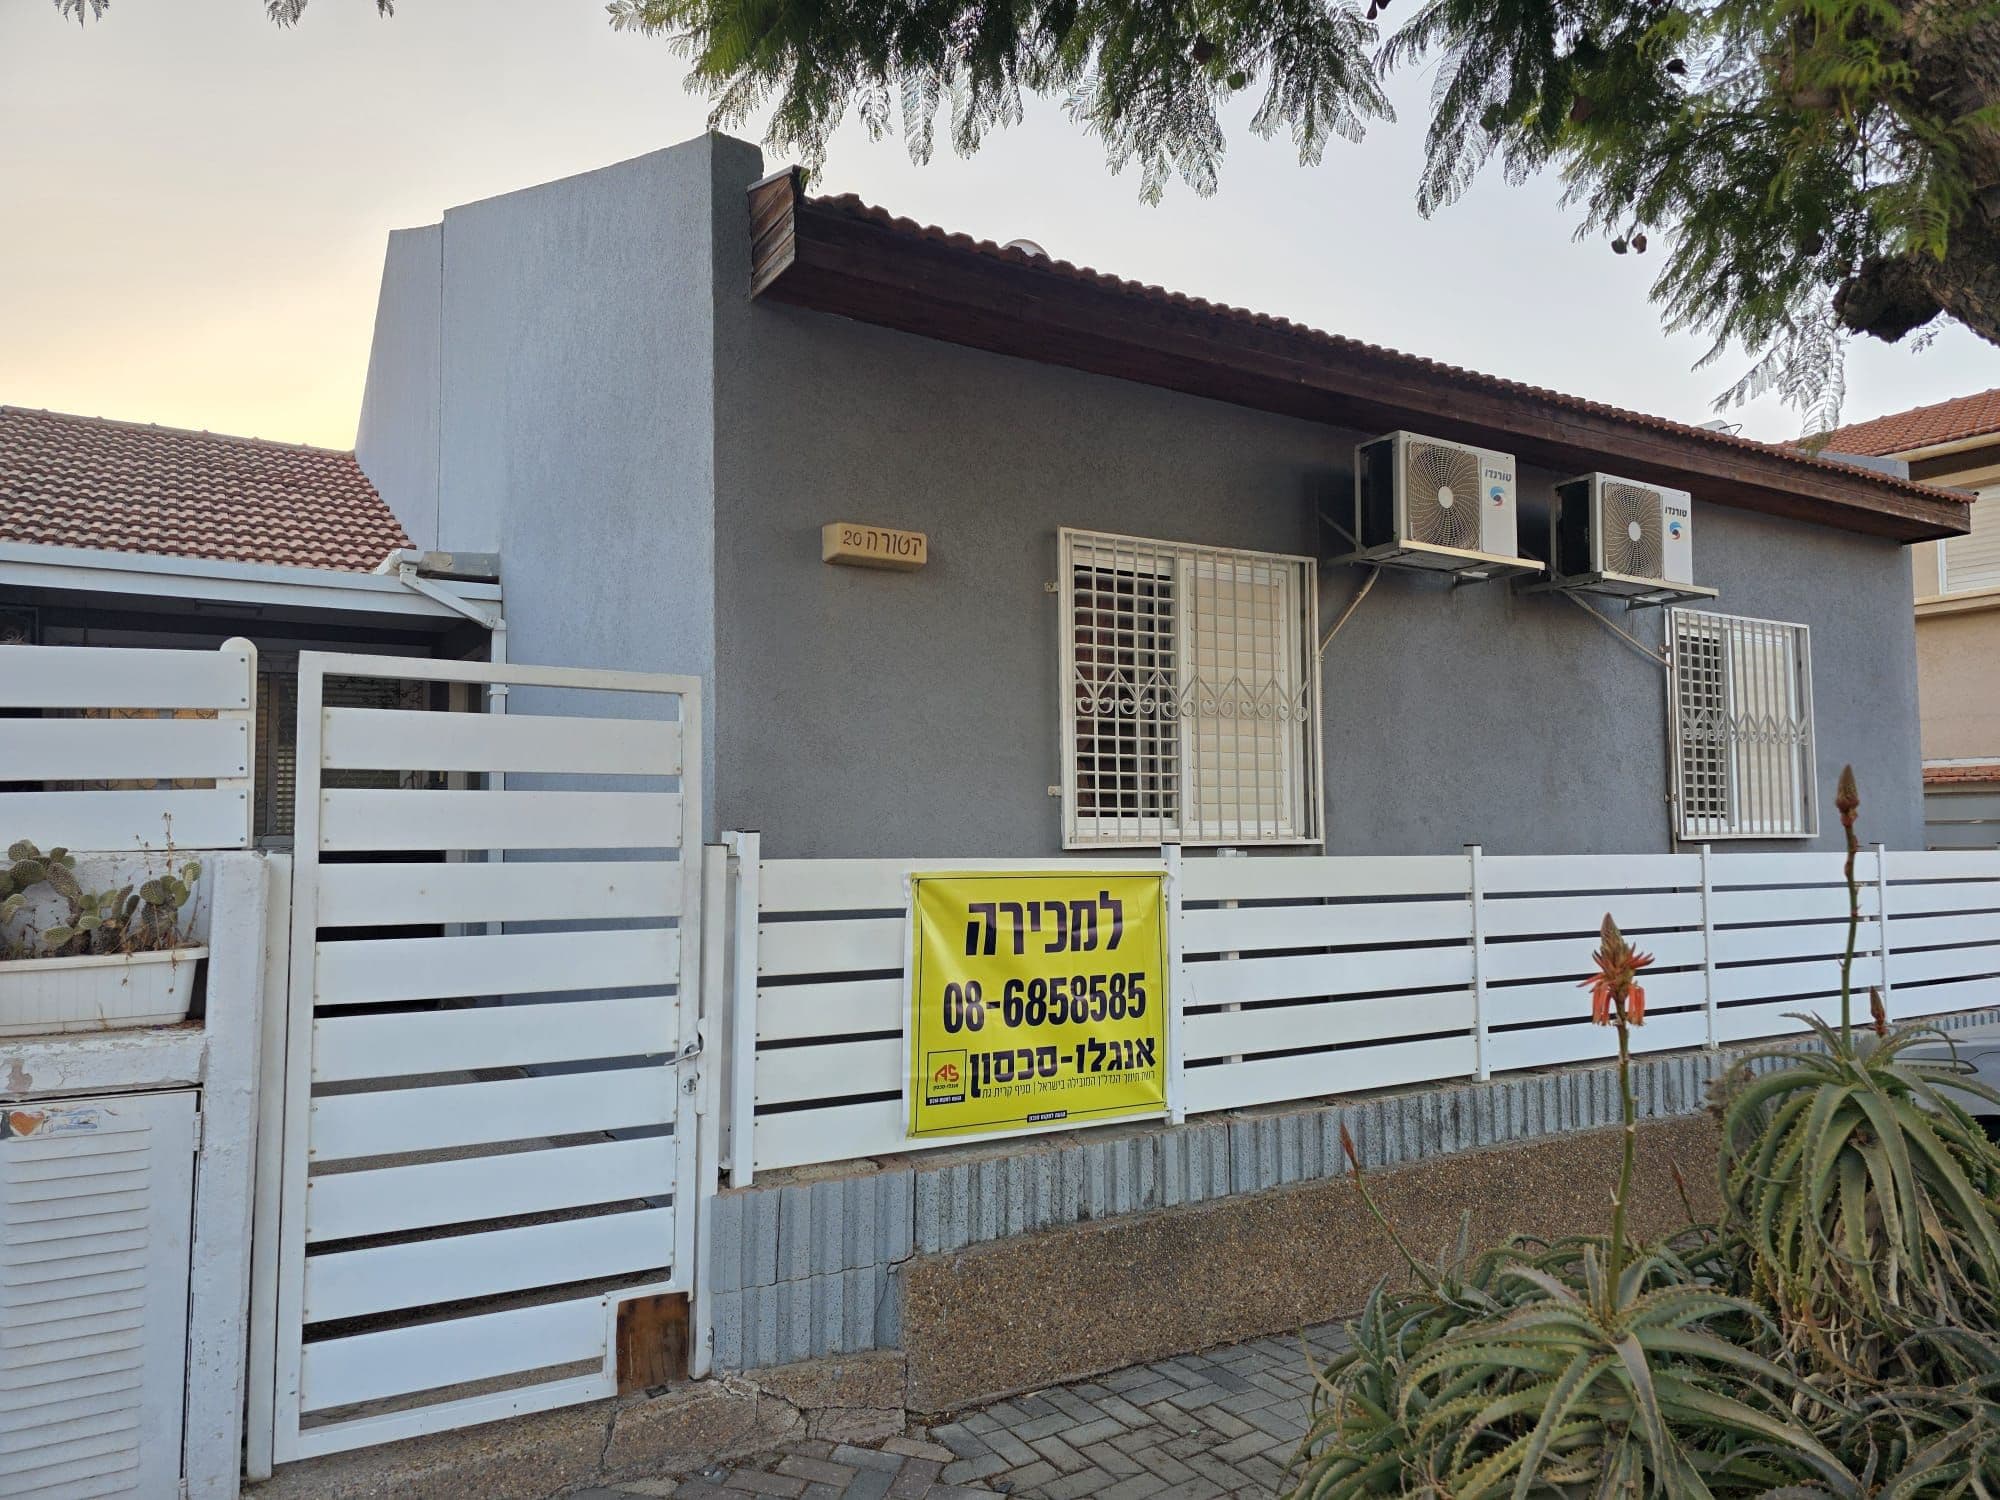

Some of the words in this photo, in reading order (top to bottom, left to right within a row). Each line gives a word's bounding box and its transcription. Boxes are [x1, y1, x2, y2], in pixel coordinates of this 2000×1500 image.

[1484, 468, 1512, 482] טורנדו
[1664, 506, 1687, 518] טורנדו
[843, 530, 862, 546] 20
[866, 531, 922, 556] קטורה
[965, 890, 1123, 956] למכירה
[943, 972, 1146, 1034] 08-6858585
[934, 1063, 960, 1083] AS
[969, 1037, 1156, 1098] אנגלו-סכסון
